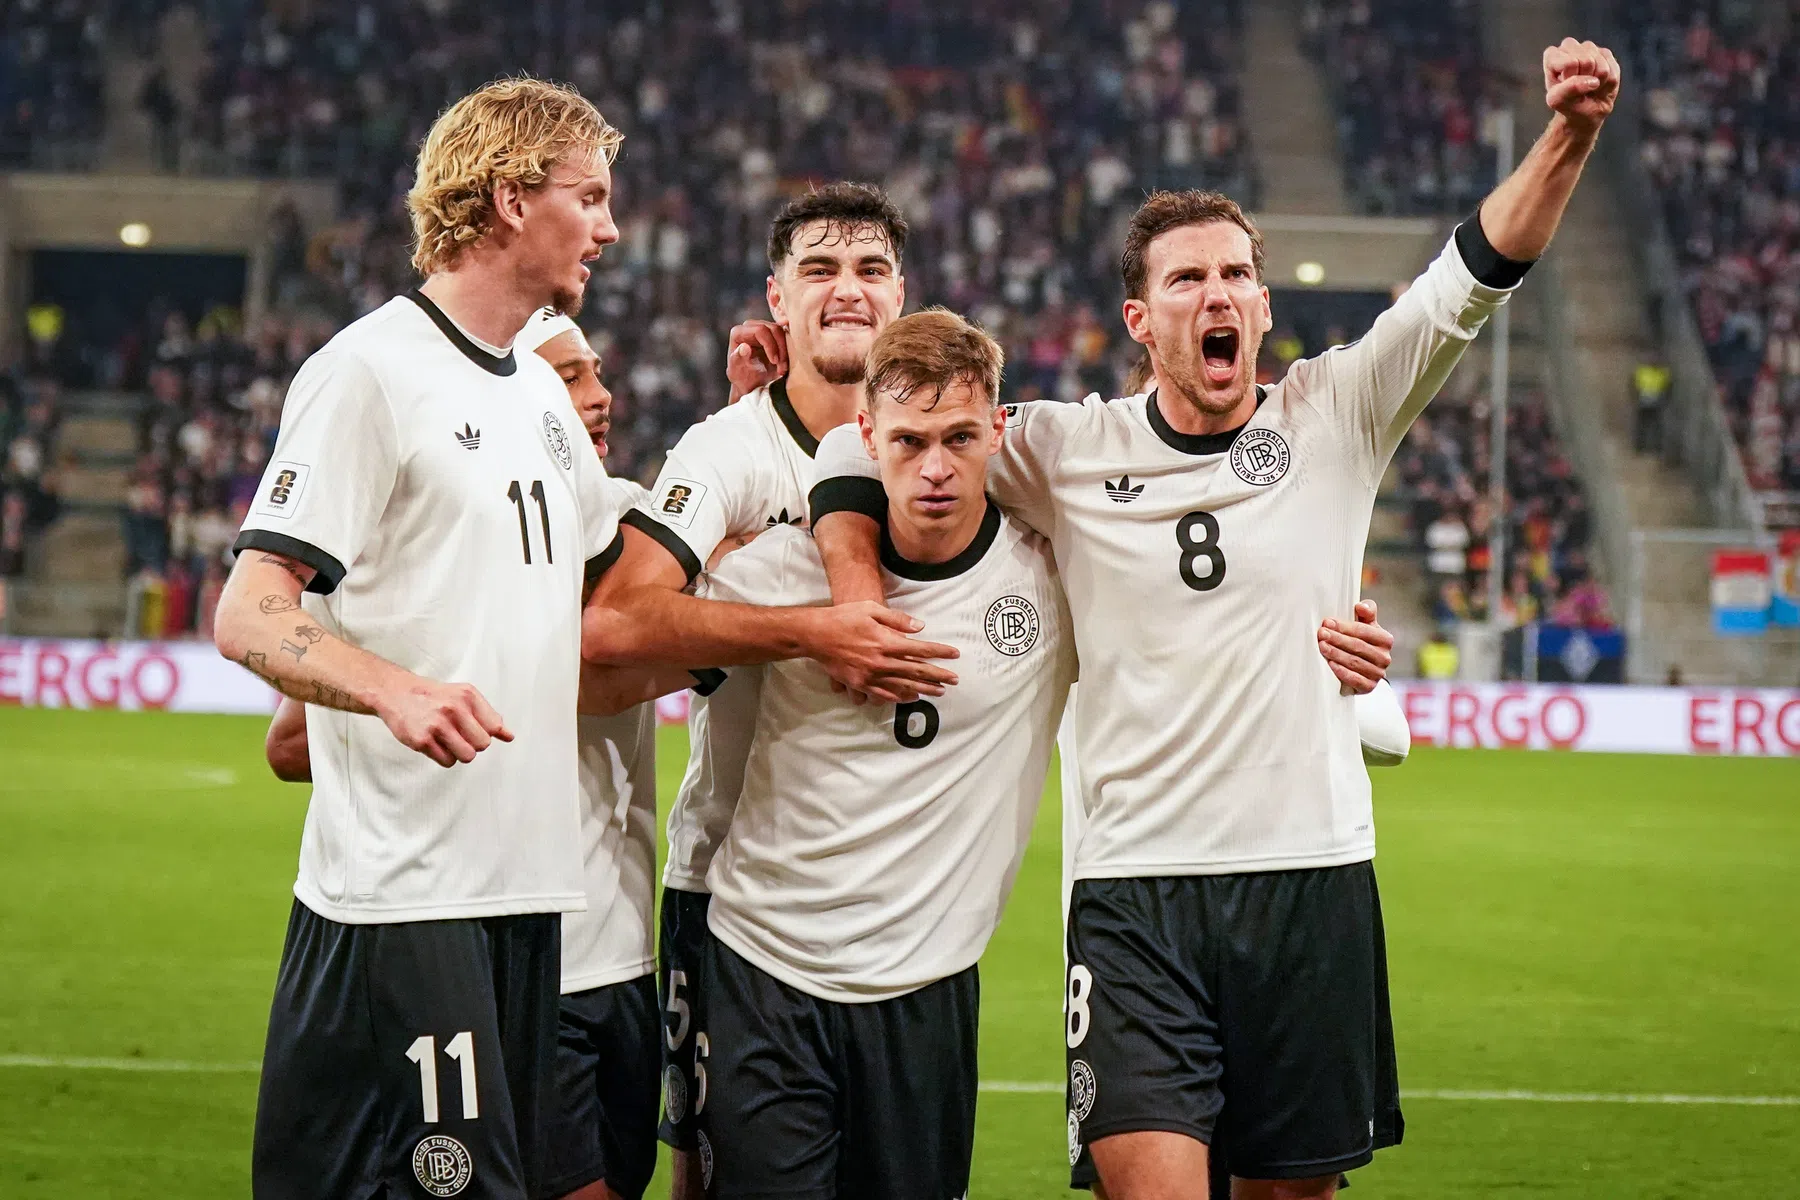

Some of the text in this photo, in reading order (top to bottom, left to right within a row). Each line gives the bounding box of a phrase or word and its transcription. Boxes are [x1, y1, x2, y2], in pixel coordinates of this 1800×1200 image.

[1233, 441, 1256, 482] DEUTSCHER
[1263, 474, 1276, 483] 125
[507, 480, 553, 565] 11
[1176, 511, 1226, 591] 8
[987, 602, 1003, 649] DEUTSCHER
[1008, 646, 1020, 654] 125
[894, 699, 939, 749] 6
[1405, 689, 1585, 748] ERGO
[666, 969, 690, 1052] 5
[1067, 964, 1093, 1049] 8
[405, 1031, 479, 1123] 11
[415, 1142, 432, 1188] DEUTSCHER
